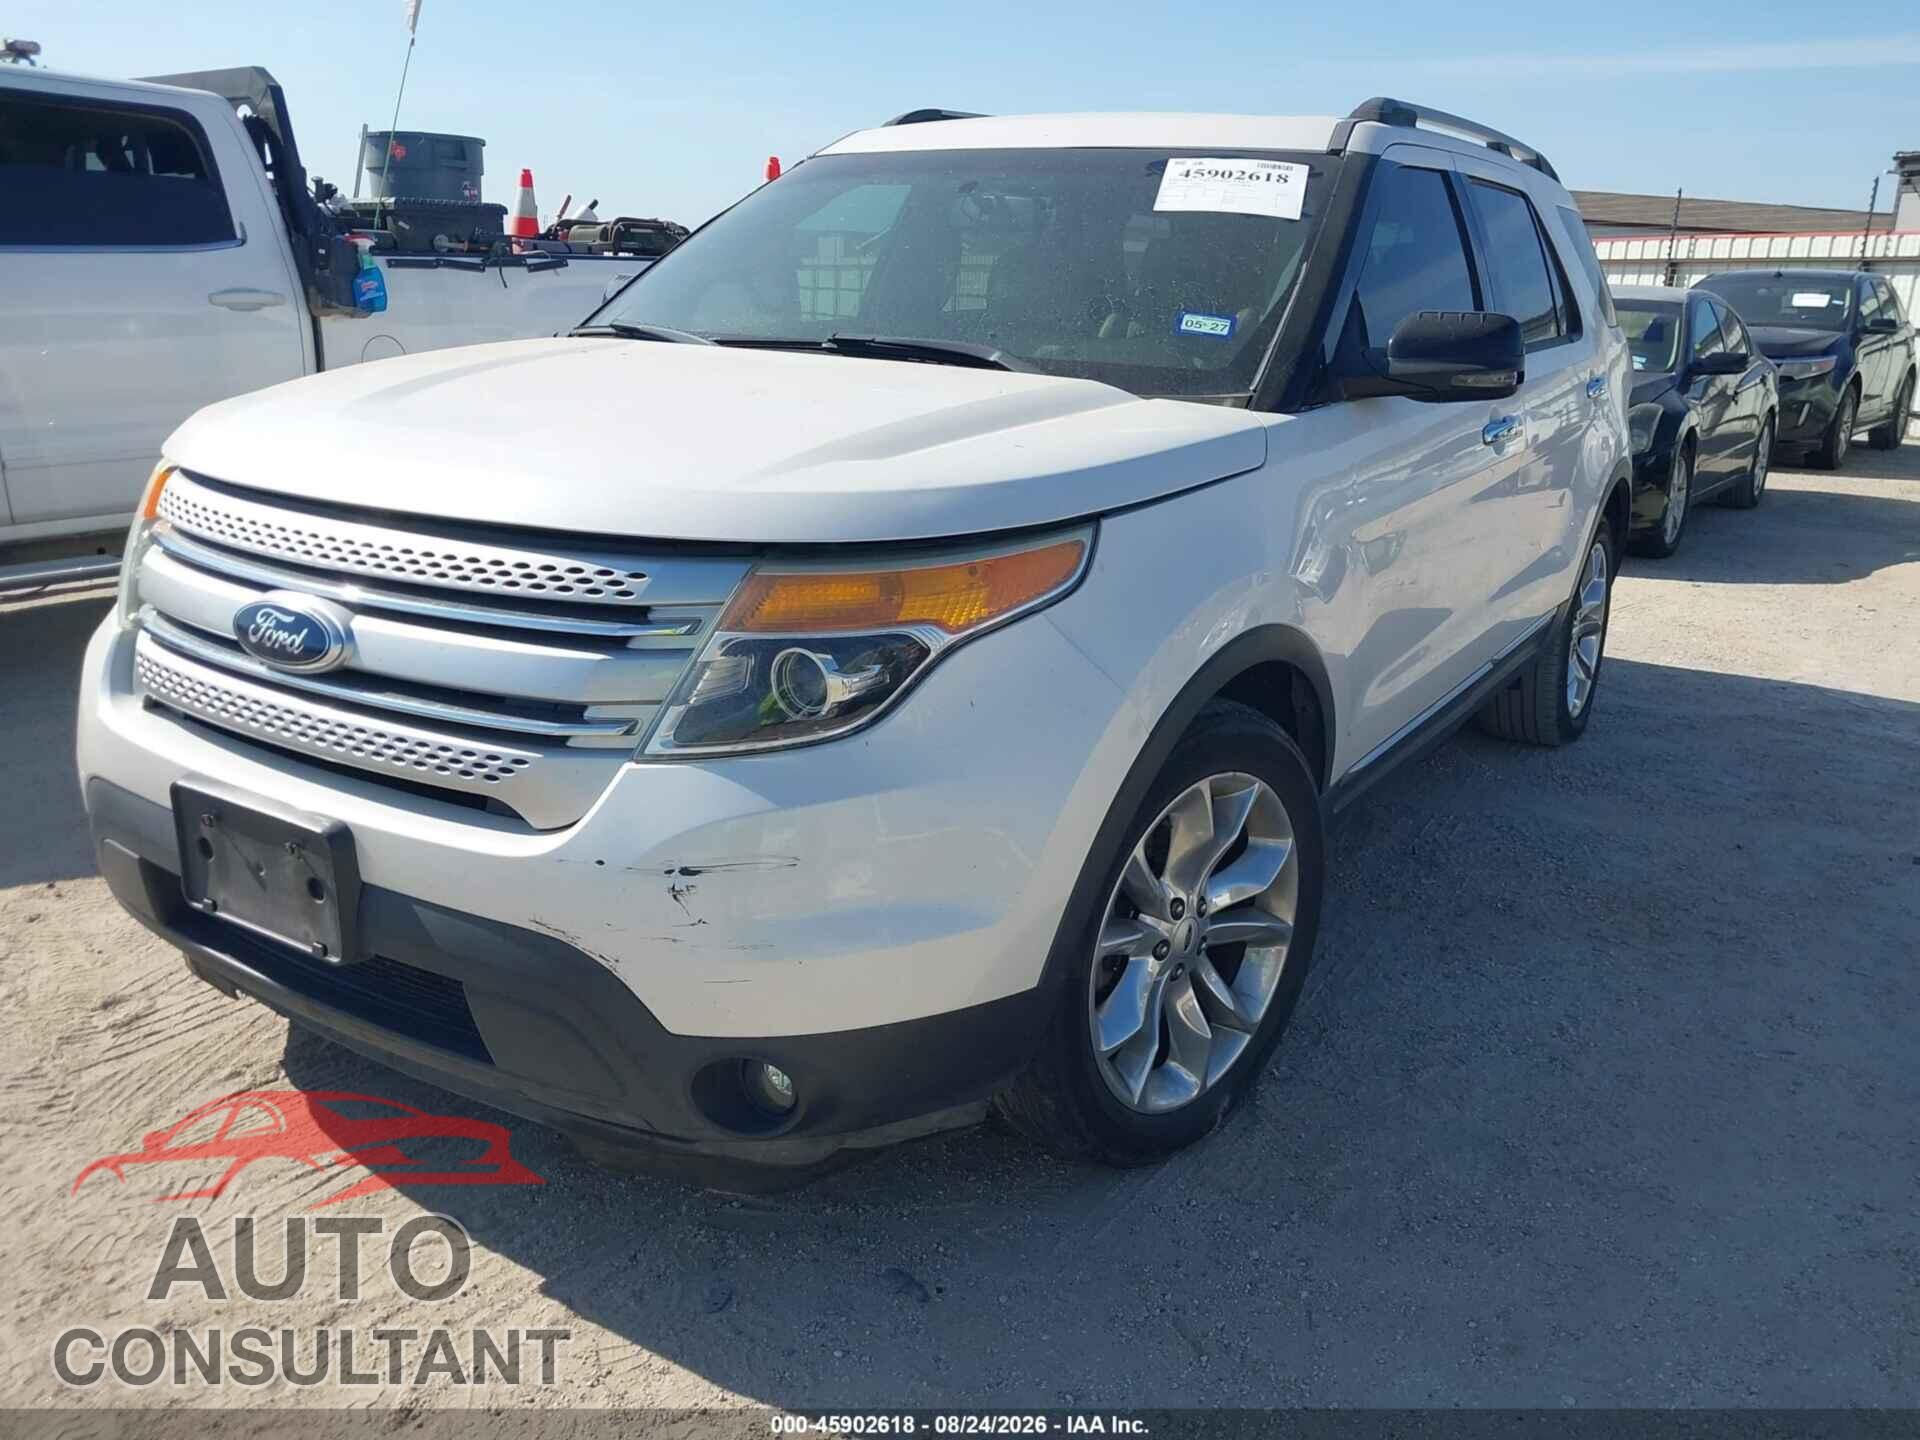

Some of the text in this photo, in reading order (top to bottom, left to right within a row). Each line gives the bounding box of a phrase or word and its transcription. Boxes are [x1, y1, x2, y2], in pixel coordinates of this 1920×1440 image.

[1178, 168, 1290, 185] 45902618
[1184, 319, 1229, 332] 05 27
[248, 607, 309, 655] Ford
